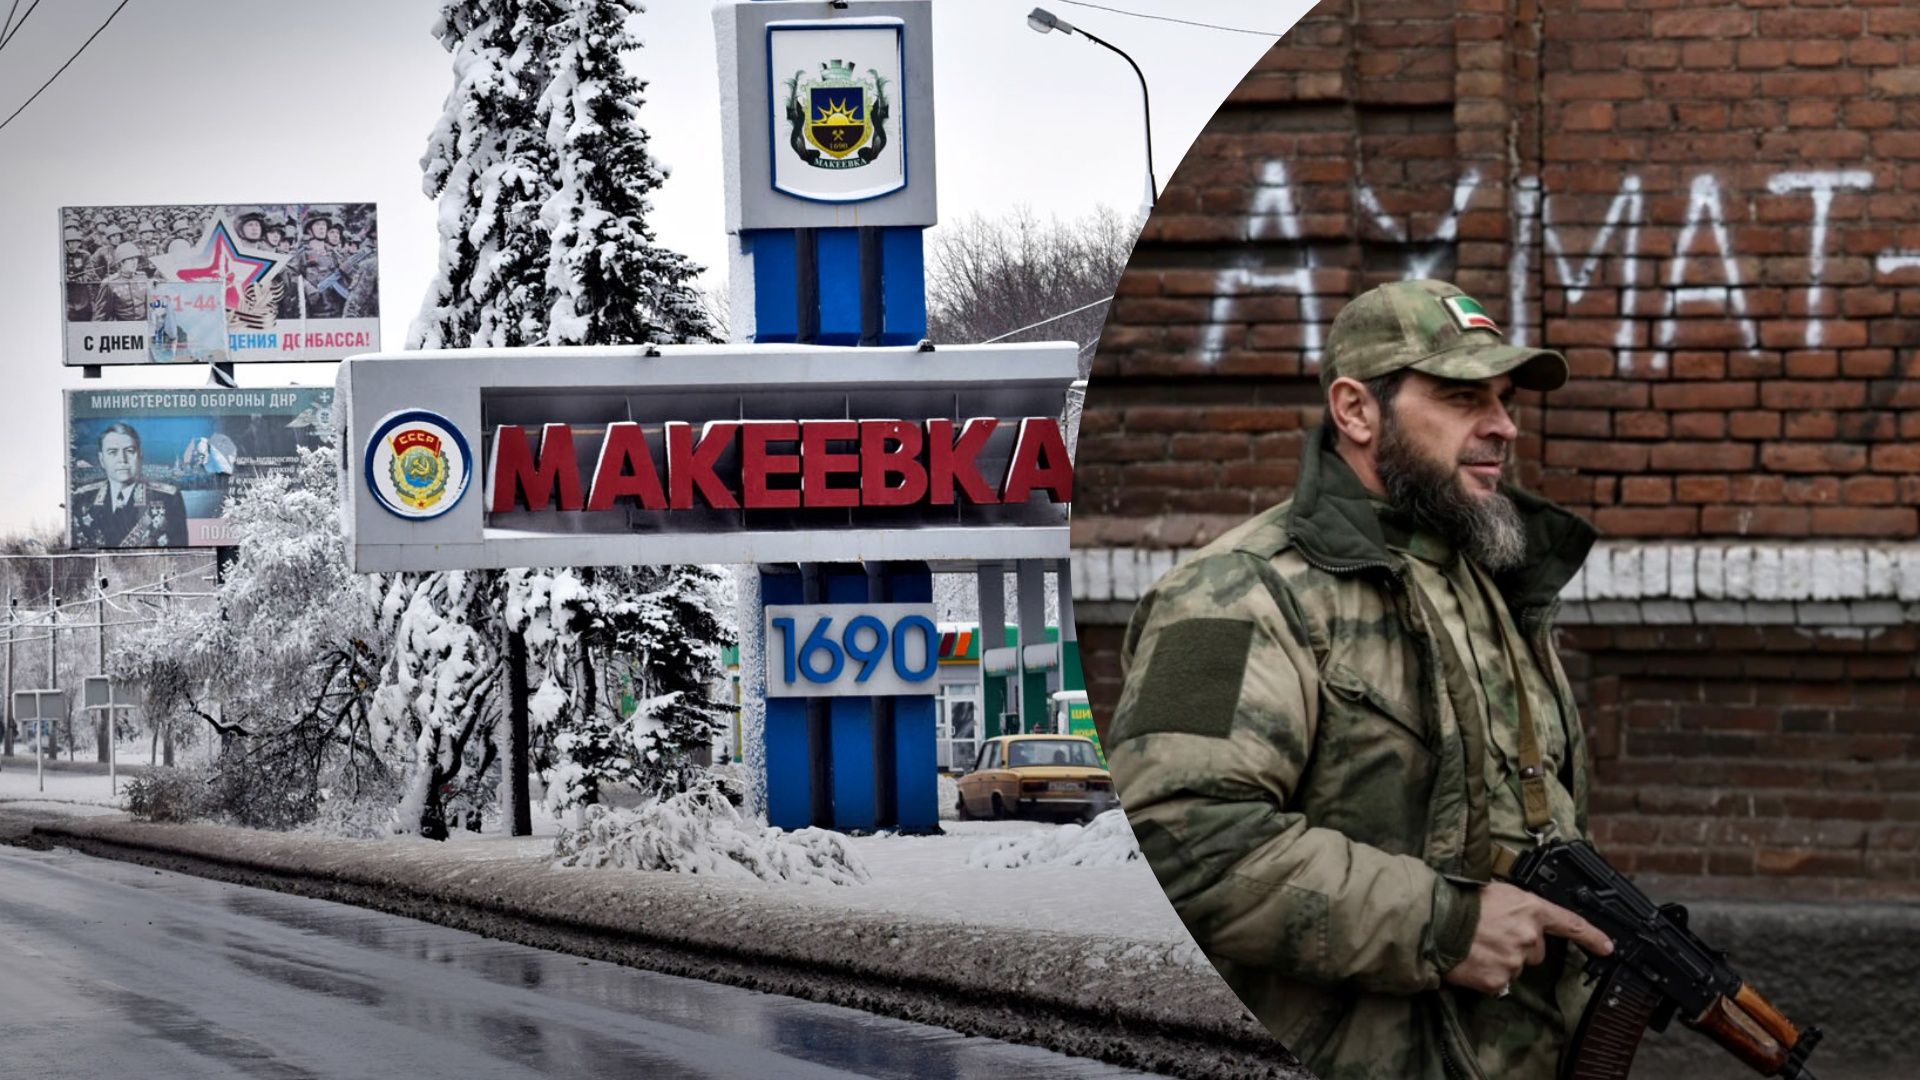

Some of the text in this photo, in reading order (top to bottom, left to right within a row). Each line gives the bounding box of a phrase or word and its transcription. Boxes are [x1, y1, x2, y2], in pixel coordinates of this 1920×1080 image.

[814, 158, 867, 168] МАКЕЕВКА
[84, 331, 370, 353] С ДНЕМ ДЕНИЯ ДОНБАССА!
[91, 392, 298, 410] МИНИСТЕРСТВО ОБОРОНЫ ДНР
[399, 433, 434, 444] СССР
[486, 416, 1074, 513] МАКЕЕВКА
[771, 614, 939, 686] 1690
[1071, 709, 1093, 719] ШИ
